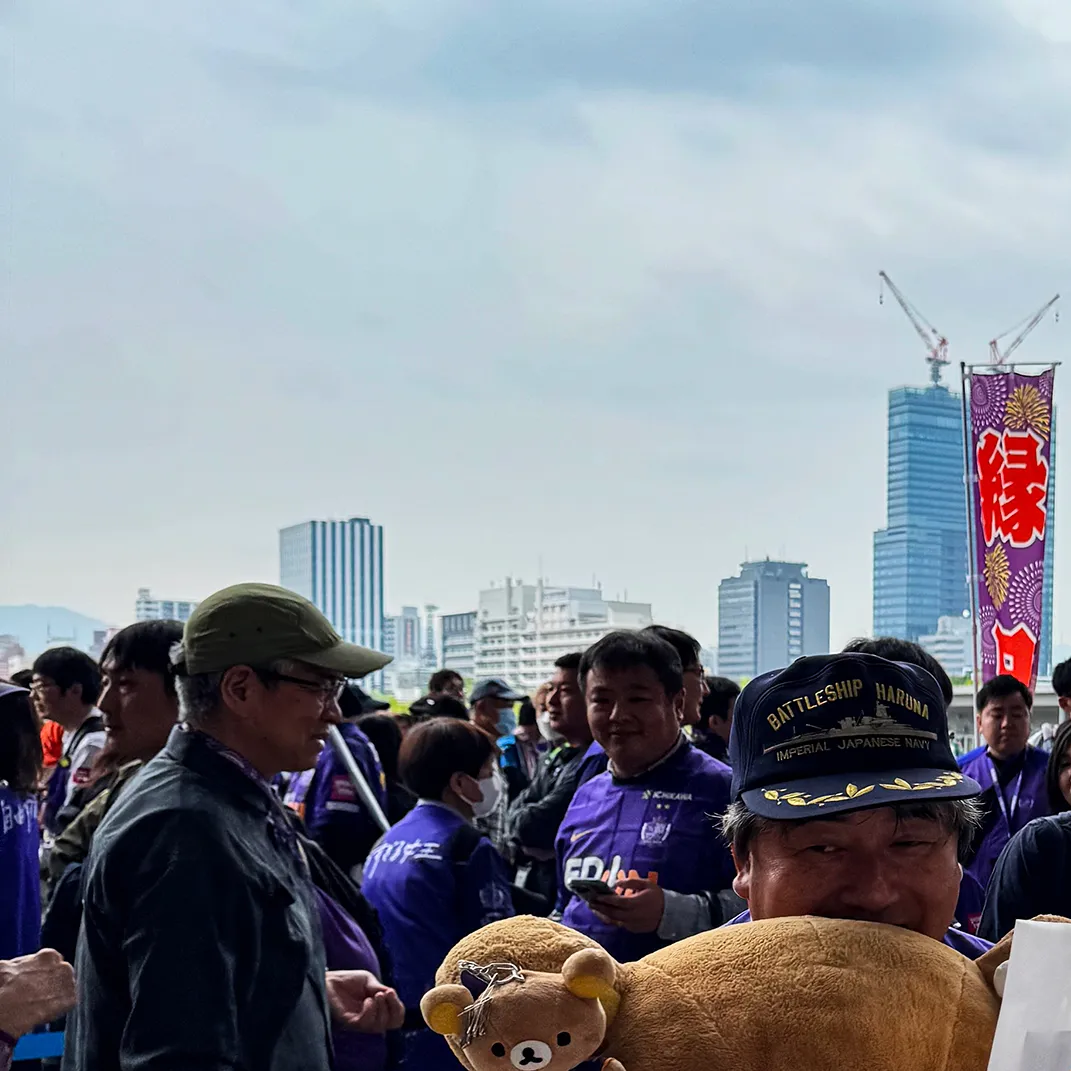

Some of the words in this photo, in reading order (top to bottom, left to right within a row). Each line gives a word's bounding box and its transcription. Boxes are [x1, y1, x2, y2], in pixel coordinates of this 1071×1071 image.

[767, 679, 864, 732] BATTLESHIP
[875, 681, 930, 721] HARUNA
[776, 741, 832, 762] IMPERIAL
[838, 736, 901, 750] JAPANESE
[904, 737, 931, 751] NAVY
